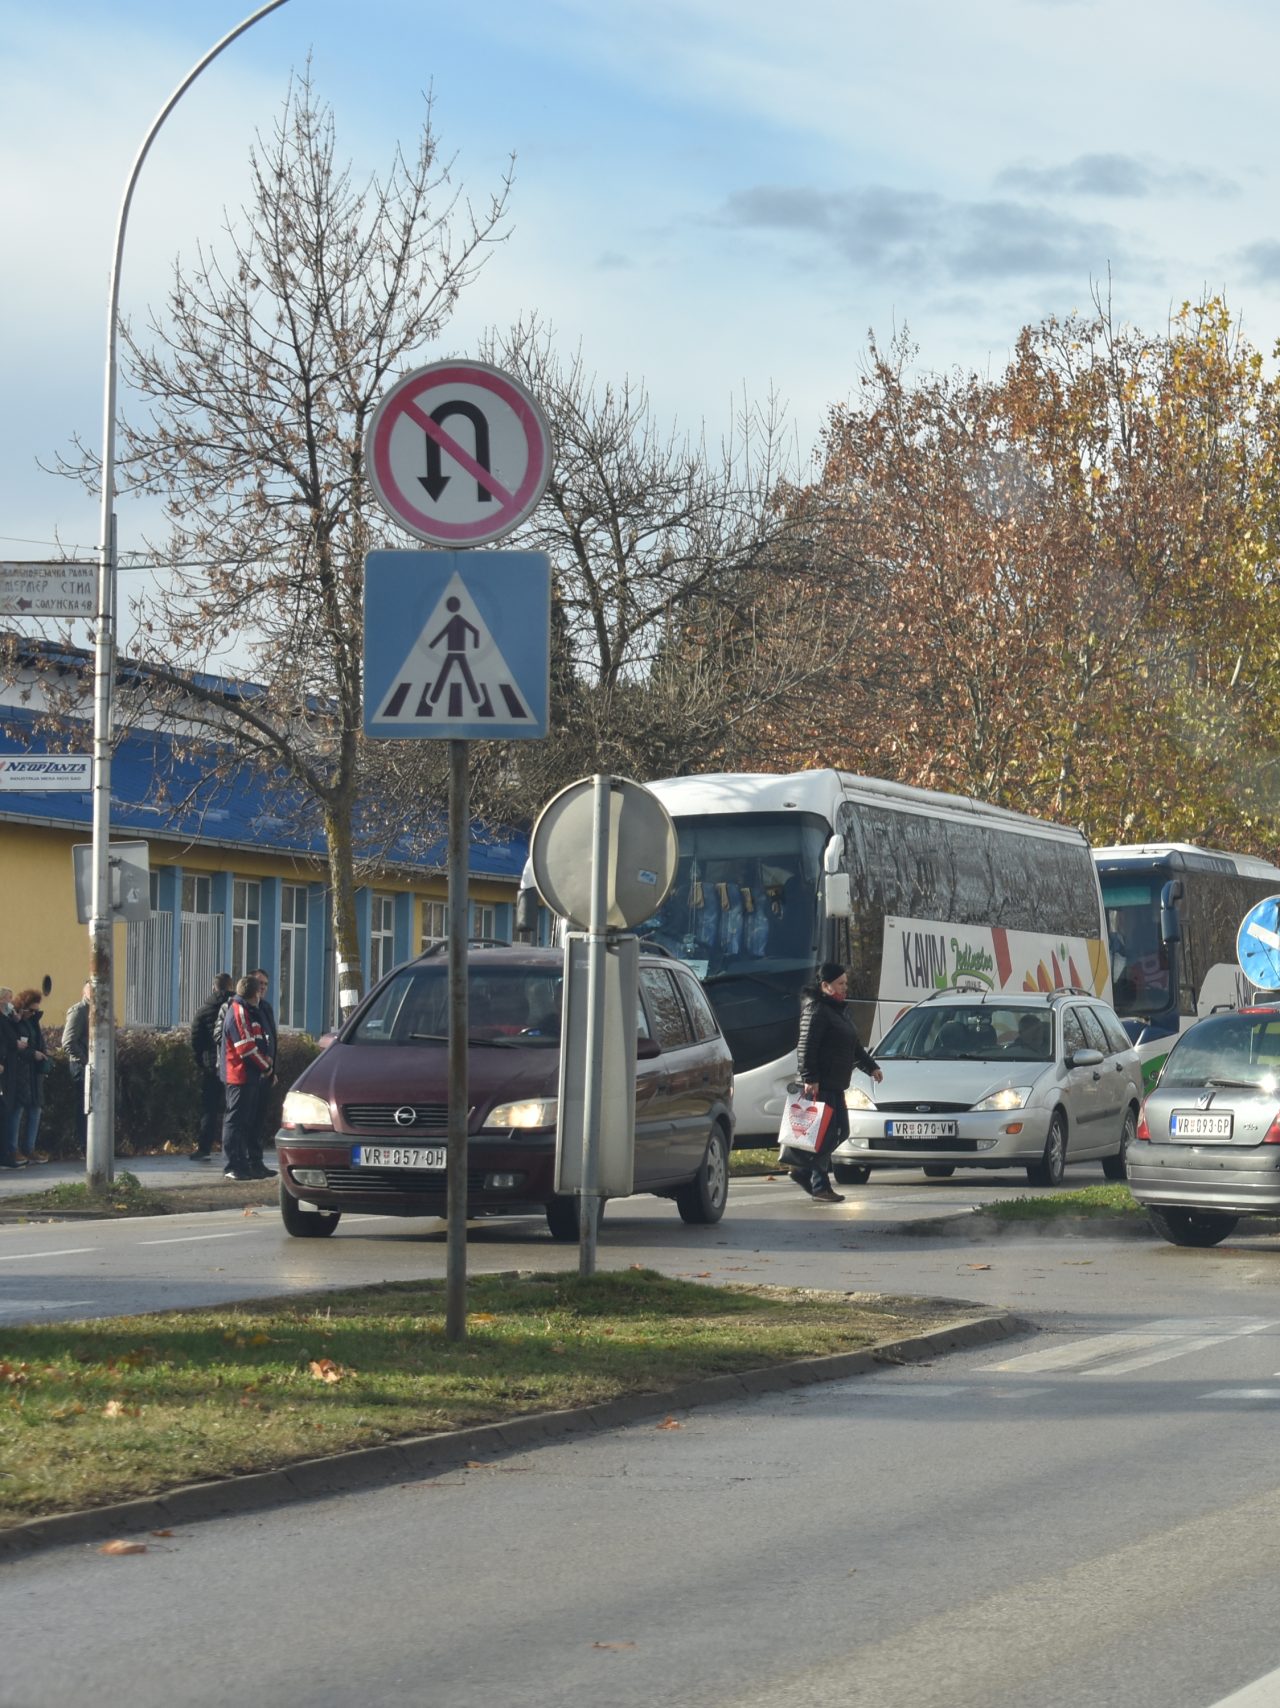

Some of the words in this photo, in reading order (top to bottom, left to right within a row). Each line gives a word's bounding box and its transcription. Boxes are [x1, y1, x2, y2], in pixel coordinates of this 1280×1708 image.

[61, 581, 91, 595] СТИЛ
[902, 931, 948, 989] KAVIM
[895, 1123, 908, 1134] VR
[1178, 1118, 1189, 1133] VR
[364, 1149, 381, 1164] VR
